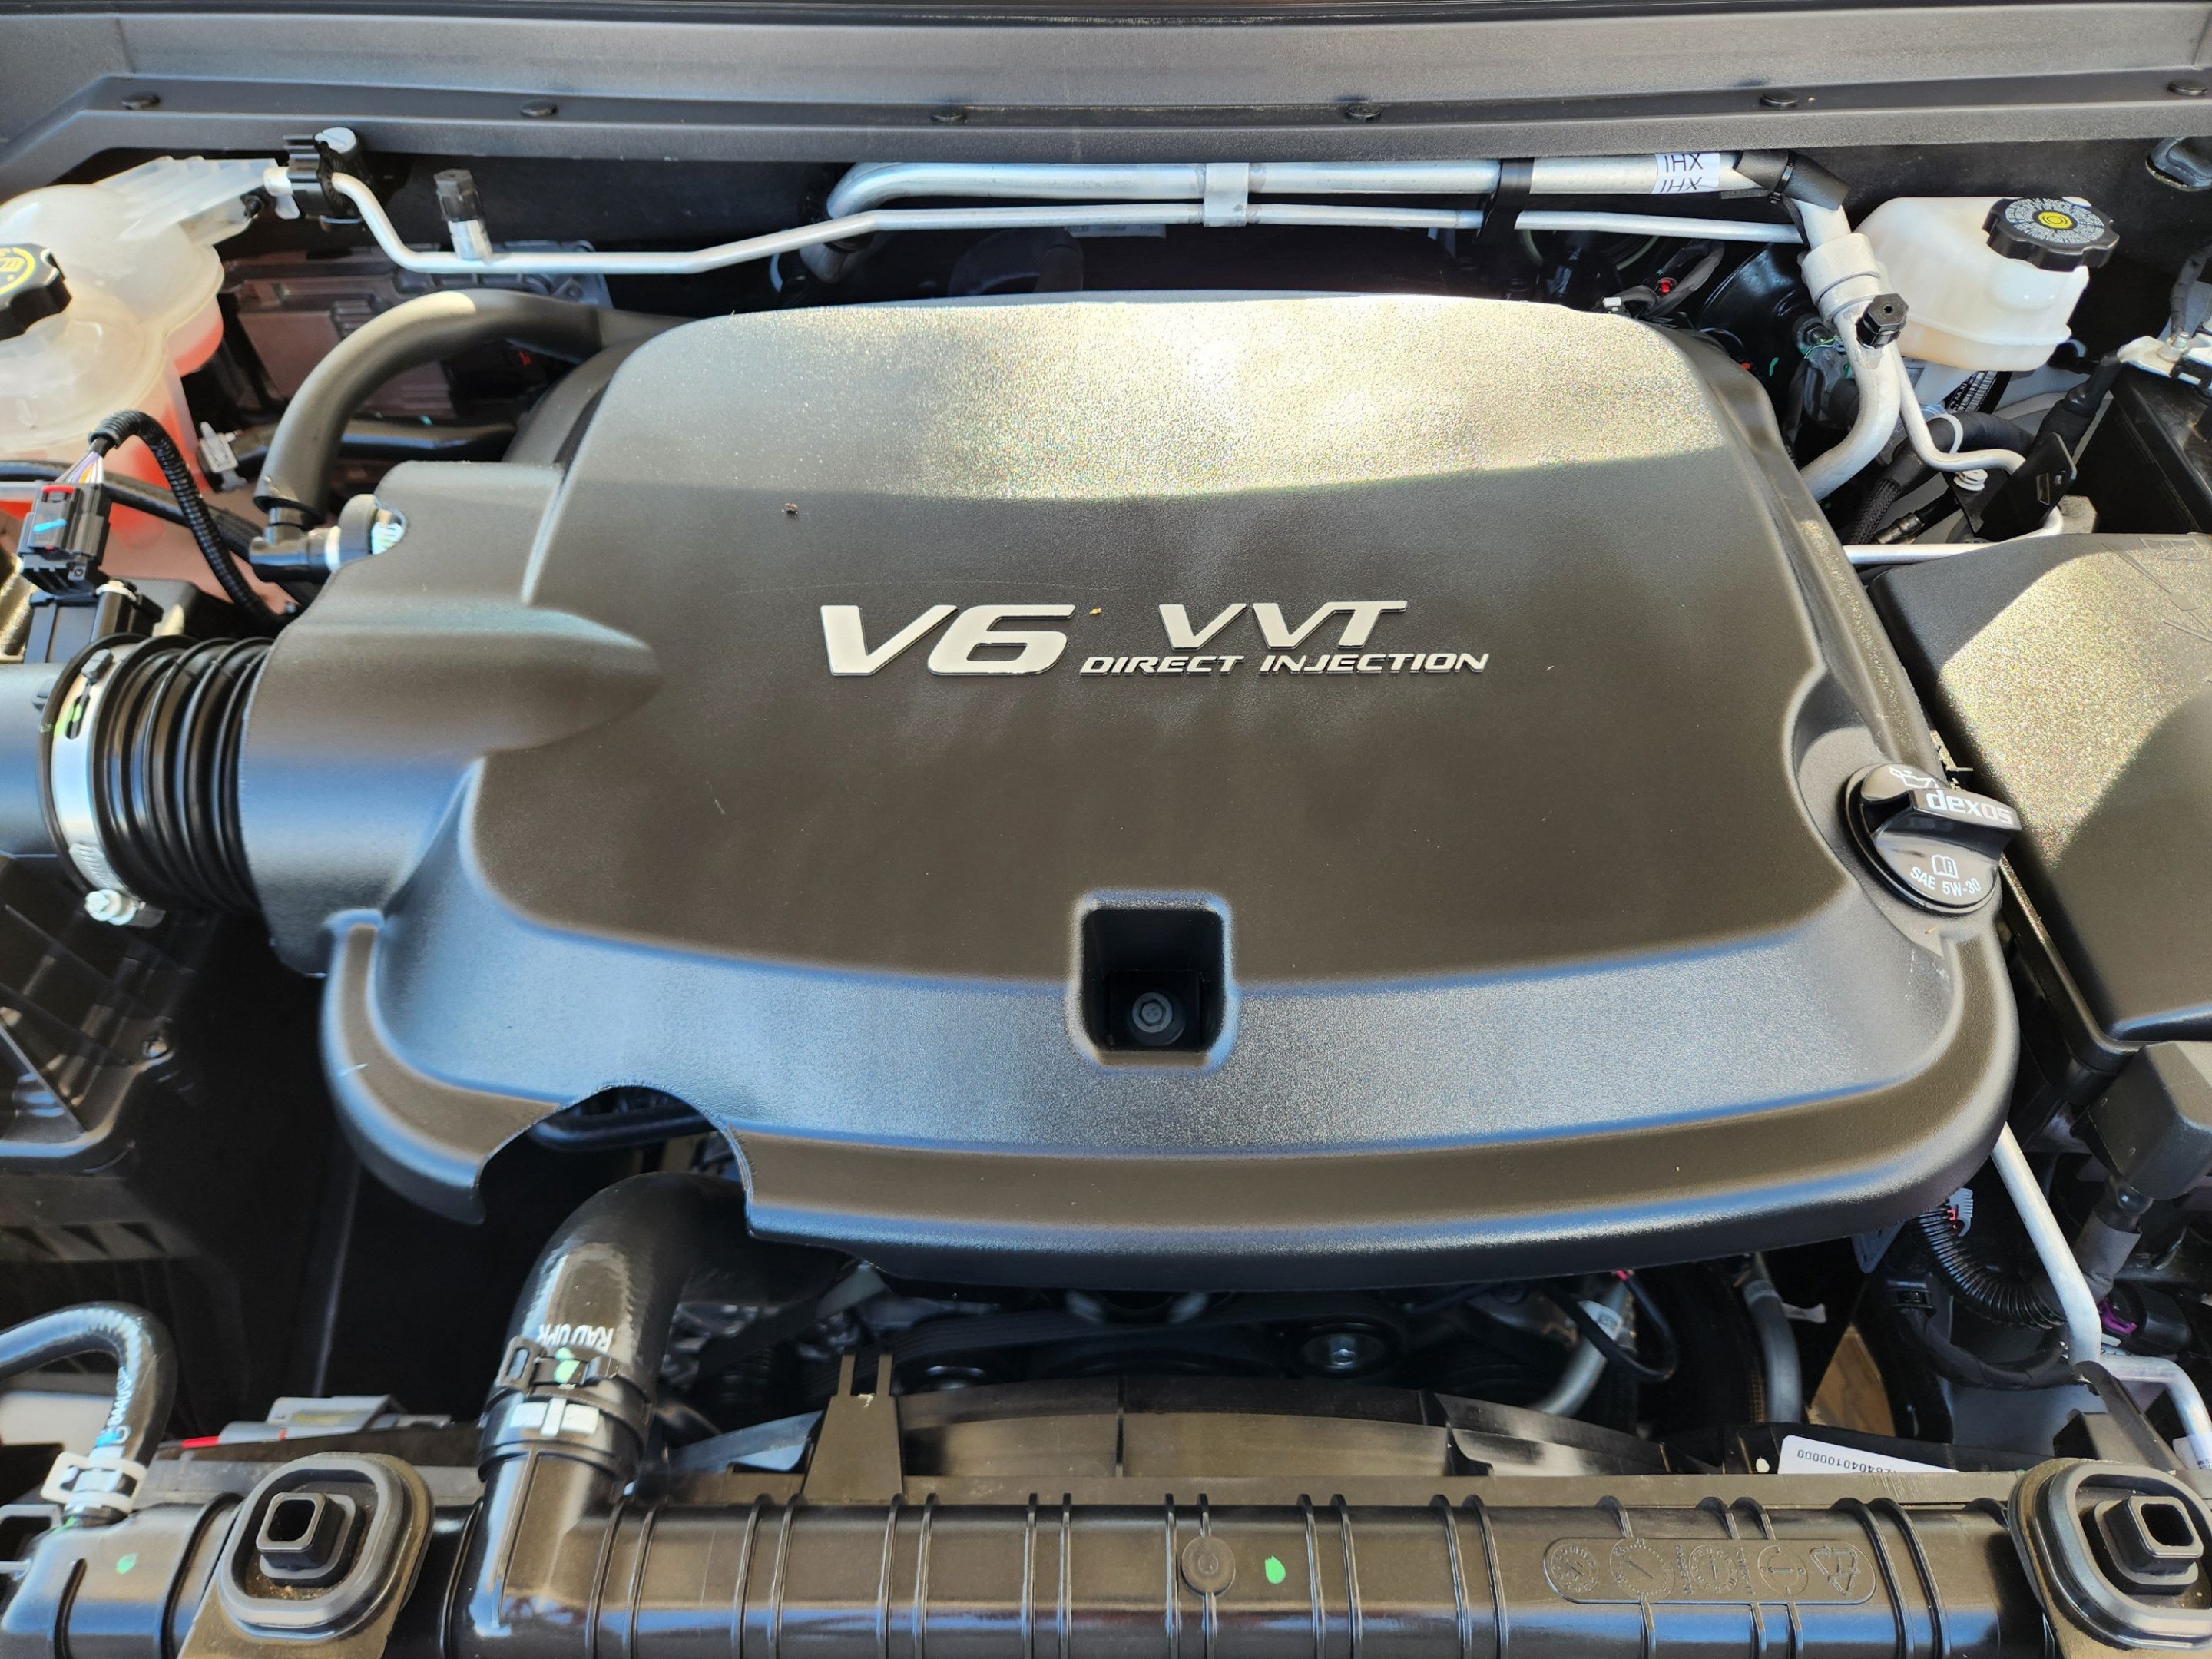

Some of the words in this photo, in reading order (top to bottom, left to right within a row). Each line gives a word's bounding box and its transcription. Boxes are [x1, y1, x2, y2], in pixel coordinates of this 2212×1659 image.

[820, 604, 1076, 676] V6
[1158, 601, 1408, 651] VVT
[1080, 655, 1244, 675] DIRECT
[1258, 653, 1489, 674] INJECTION
[1926, 789, 2013, 825] dexos
[1909, 866, 1936, 890] SAE
[1942, 877, 1981, 897] 5W-30
